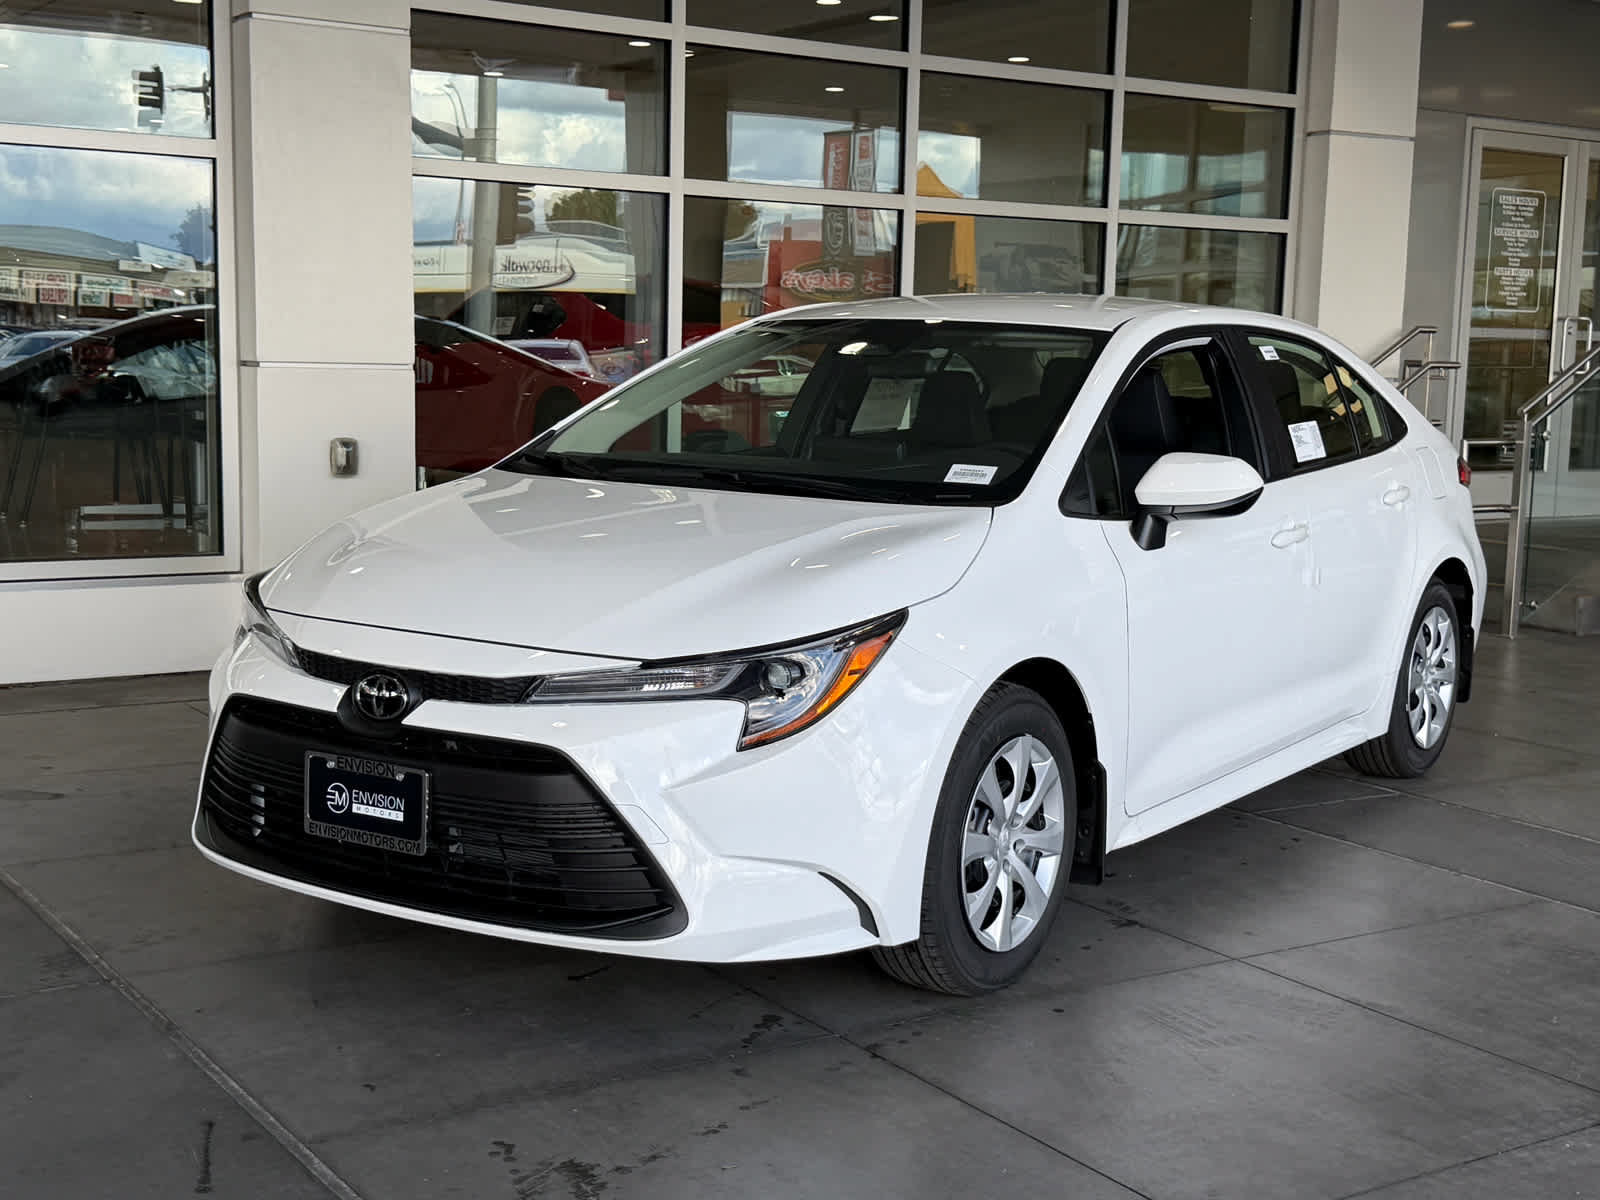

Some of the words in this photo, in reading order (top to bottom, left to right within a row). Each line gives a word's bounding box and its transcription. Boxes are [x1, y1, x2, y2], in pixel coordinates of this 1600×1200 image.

[337, 757, 395, 777] ENVISION
[352, 789, 405, 811] ENVISION
[308, 822, 420, 853] ENVISIONMOTORS.COM
